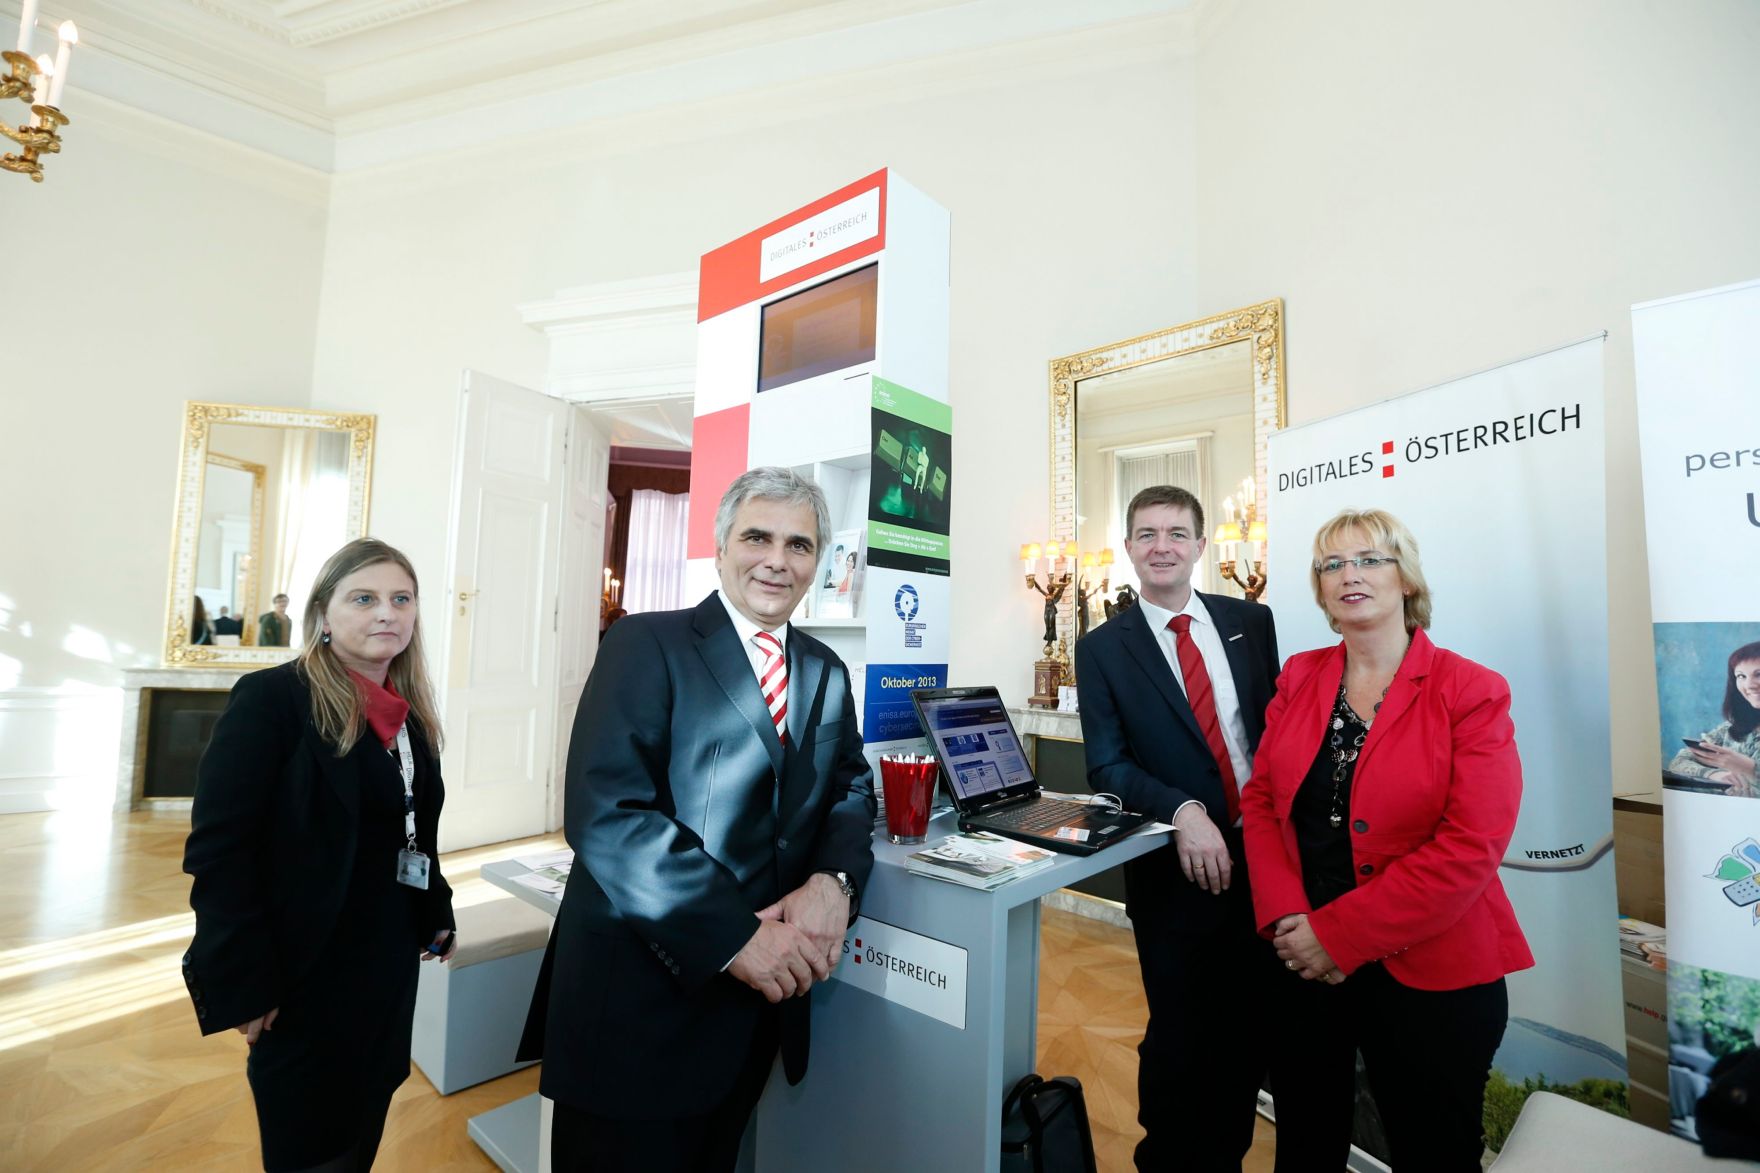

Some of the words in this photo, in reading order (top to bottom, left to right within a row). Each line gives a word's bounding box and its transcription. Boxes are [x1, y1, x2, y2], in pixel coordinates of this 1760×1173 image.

[770, 239, 807, 262] DIGITALES
[816, 211, 868, 241] ÖSTERREICH
[1278, 451, 1374, 492] DIGITALES
[1405, 403, 1581, 463] ÖSTERREICH
[881, 676, 915, 689] Oktober
[918, 676, 937, 688] 2013
[1525, 843, 1585, 859] VERNETZT
[866, 945, 947, 990] ÖSTERREICH
